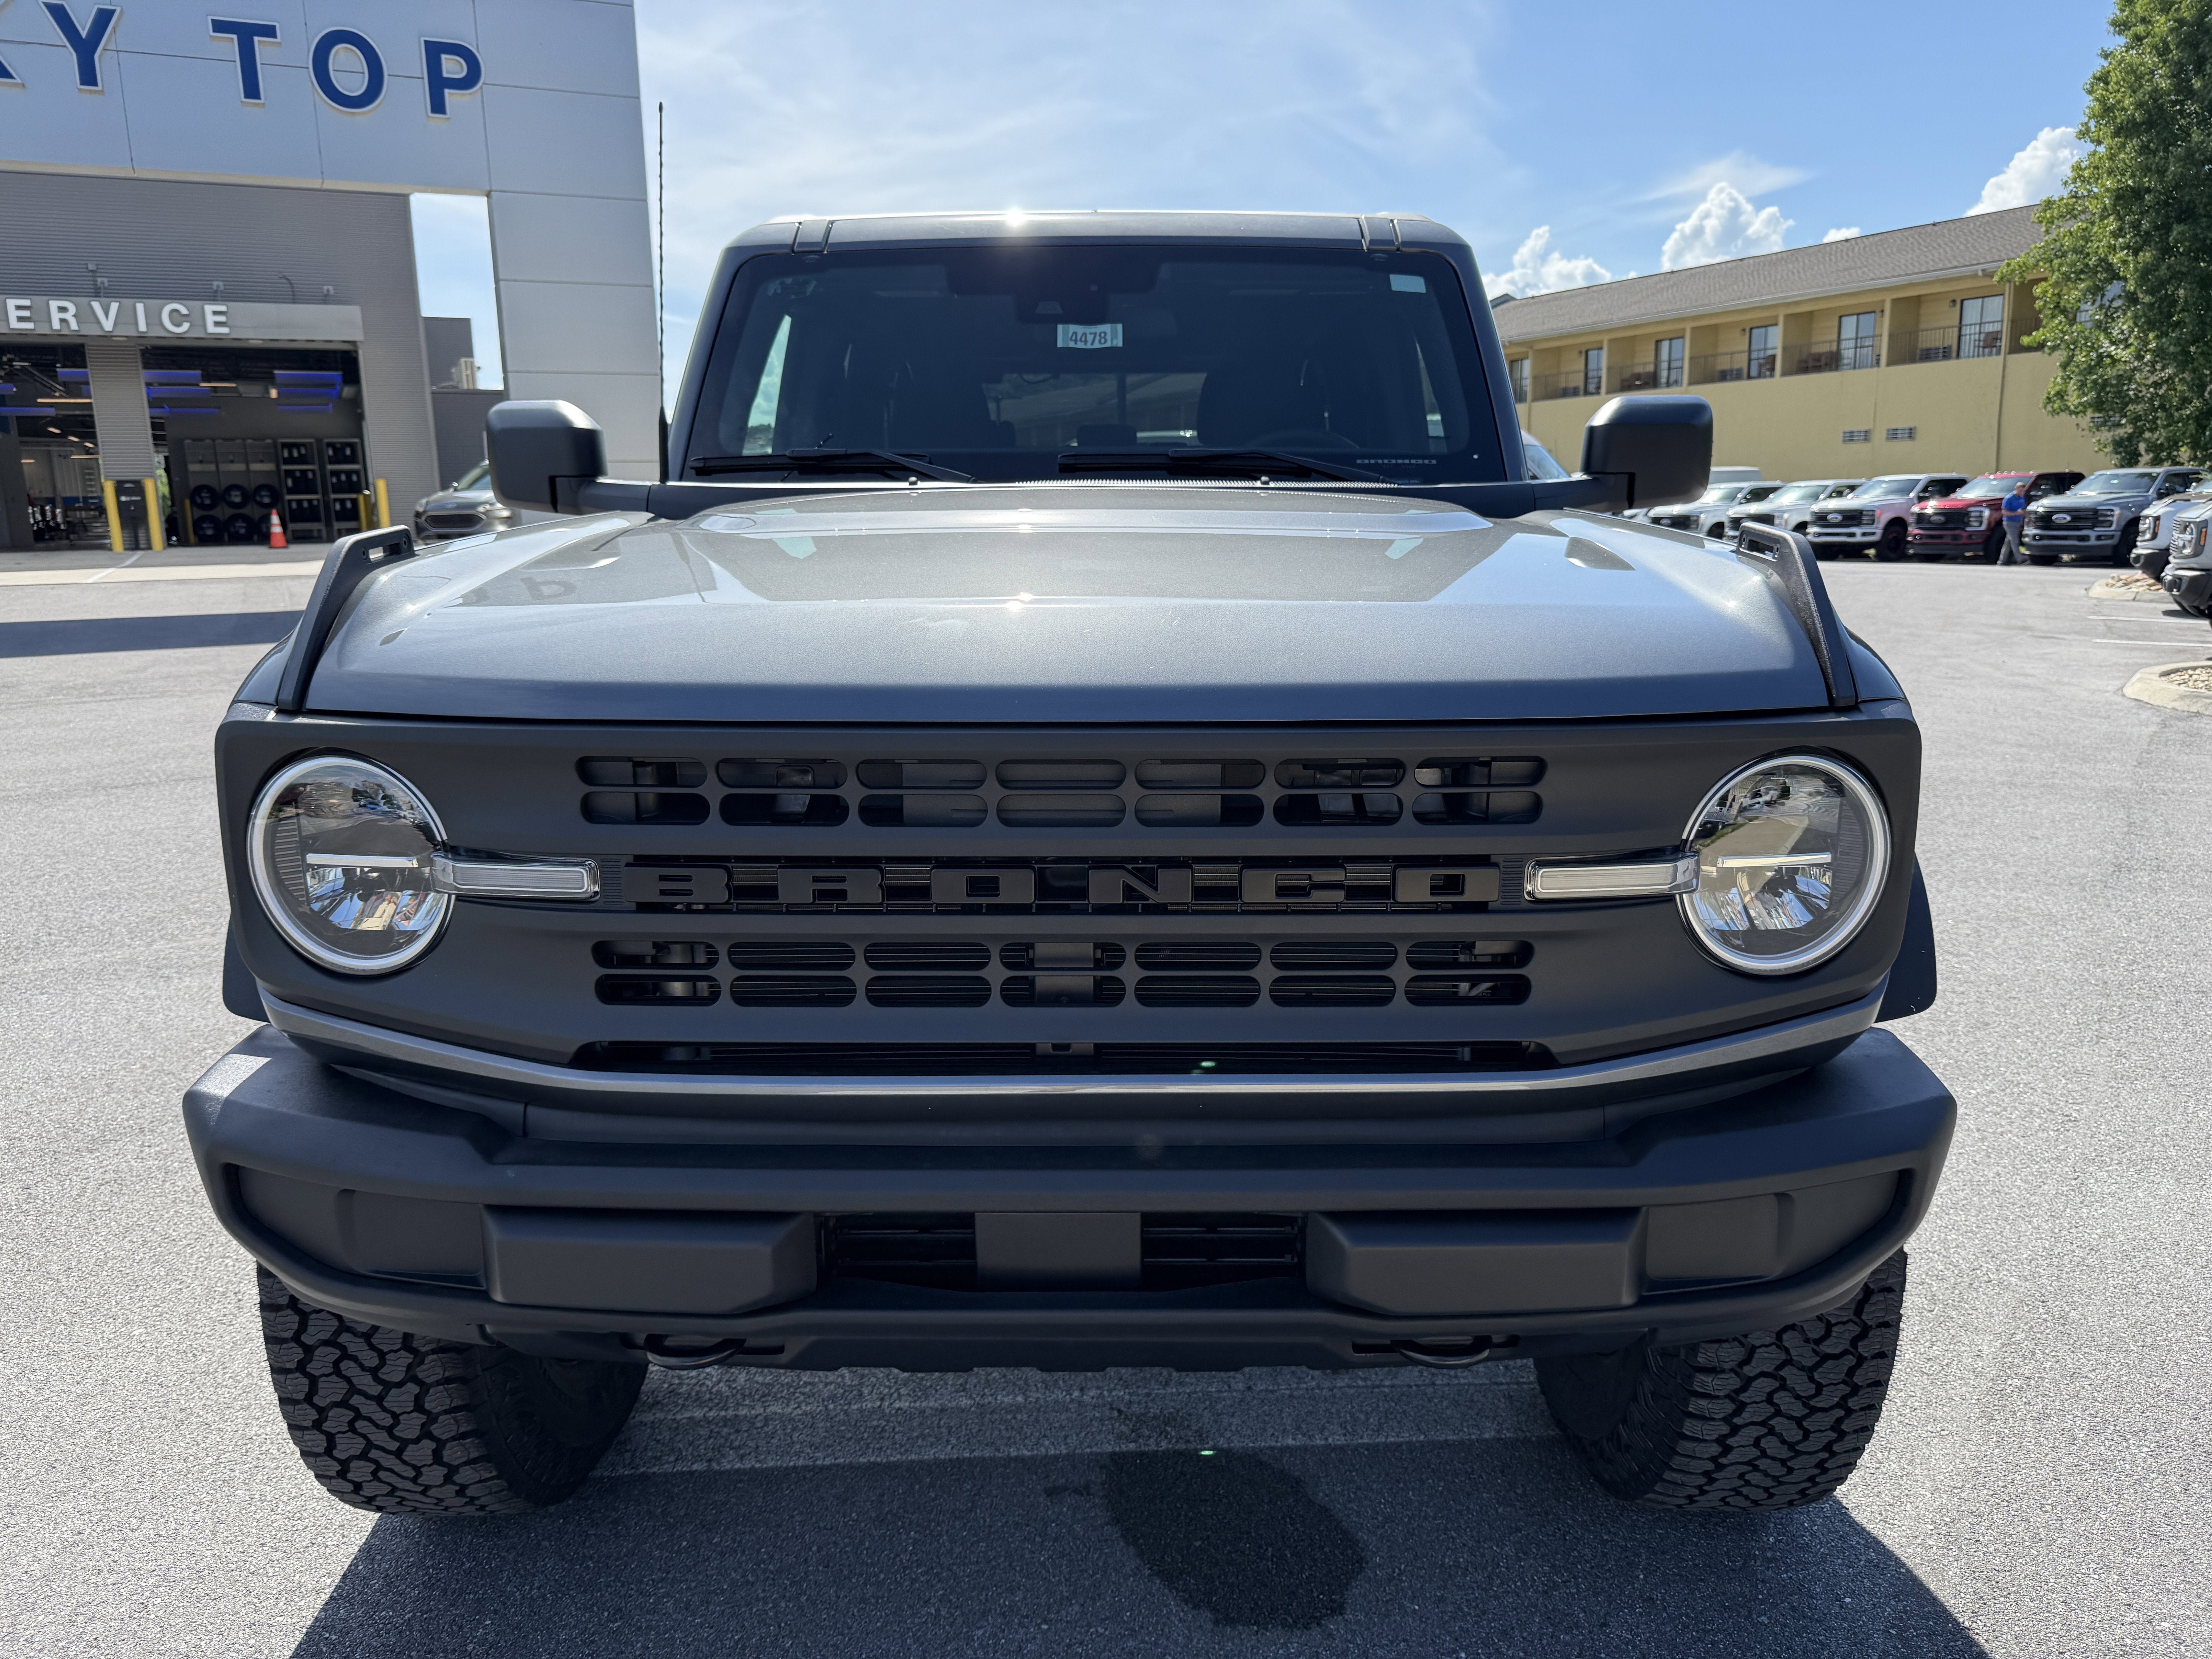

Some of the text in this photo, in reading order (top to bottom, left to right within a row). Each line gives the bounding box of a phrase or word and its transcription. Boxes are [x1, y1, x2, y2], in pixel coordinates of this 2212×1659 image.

[0, 0, 484, 118] Y TOP
[6, 298, 230, 334] ERVICE
[1069, 331, 1108, 346] 4478
[623, 866, 1500, 903] BRONCO
